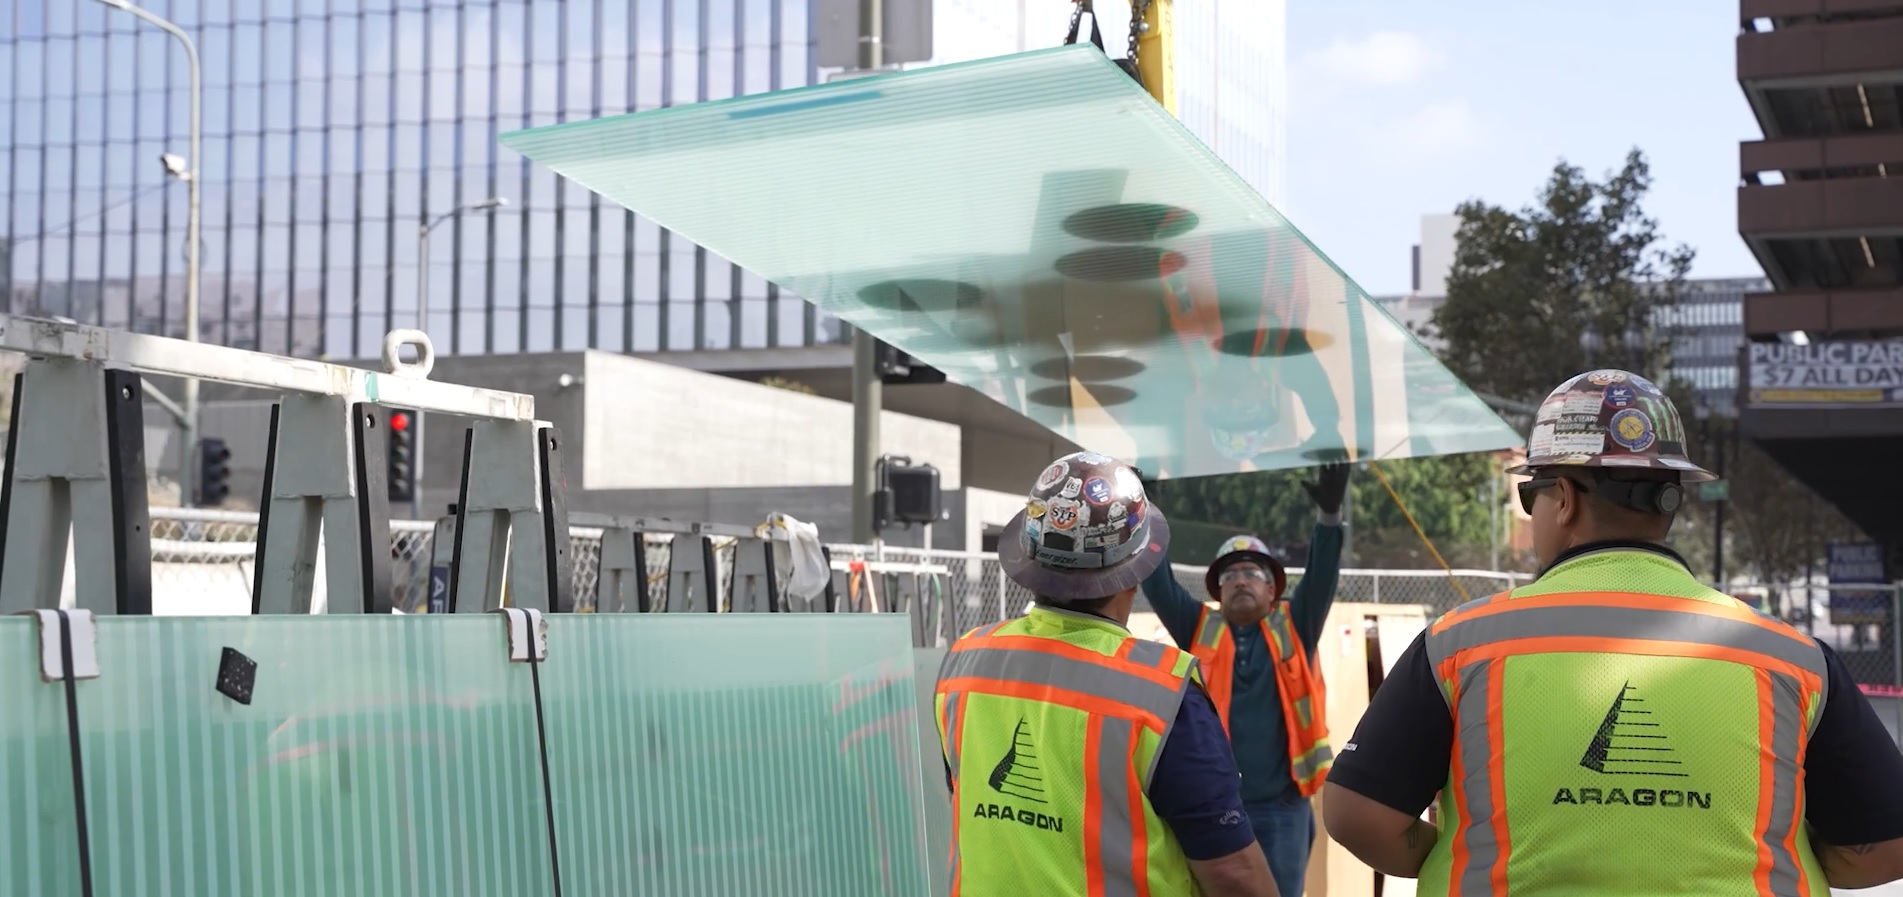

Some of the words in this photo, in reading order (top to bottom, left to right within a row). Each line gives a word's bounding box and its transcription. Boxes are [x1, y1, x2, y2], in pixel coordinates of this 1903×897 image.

[1750, 342, 1845, 364] PUBLIC
[1852, 342, 1903, 364] PAR
[1764, 367, 1795, 386] $7
[1801, 367, 1848, 385] ALL
[1552, 787, 1712, 810] ARAGON
[974, 803, 1063, 833] ARAGON
